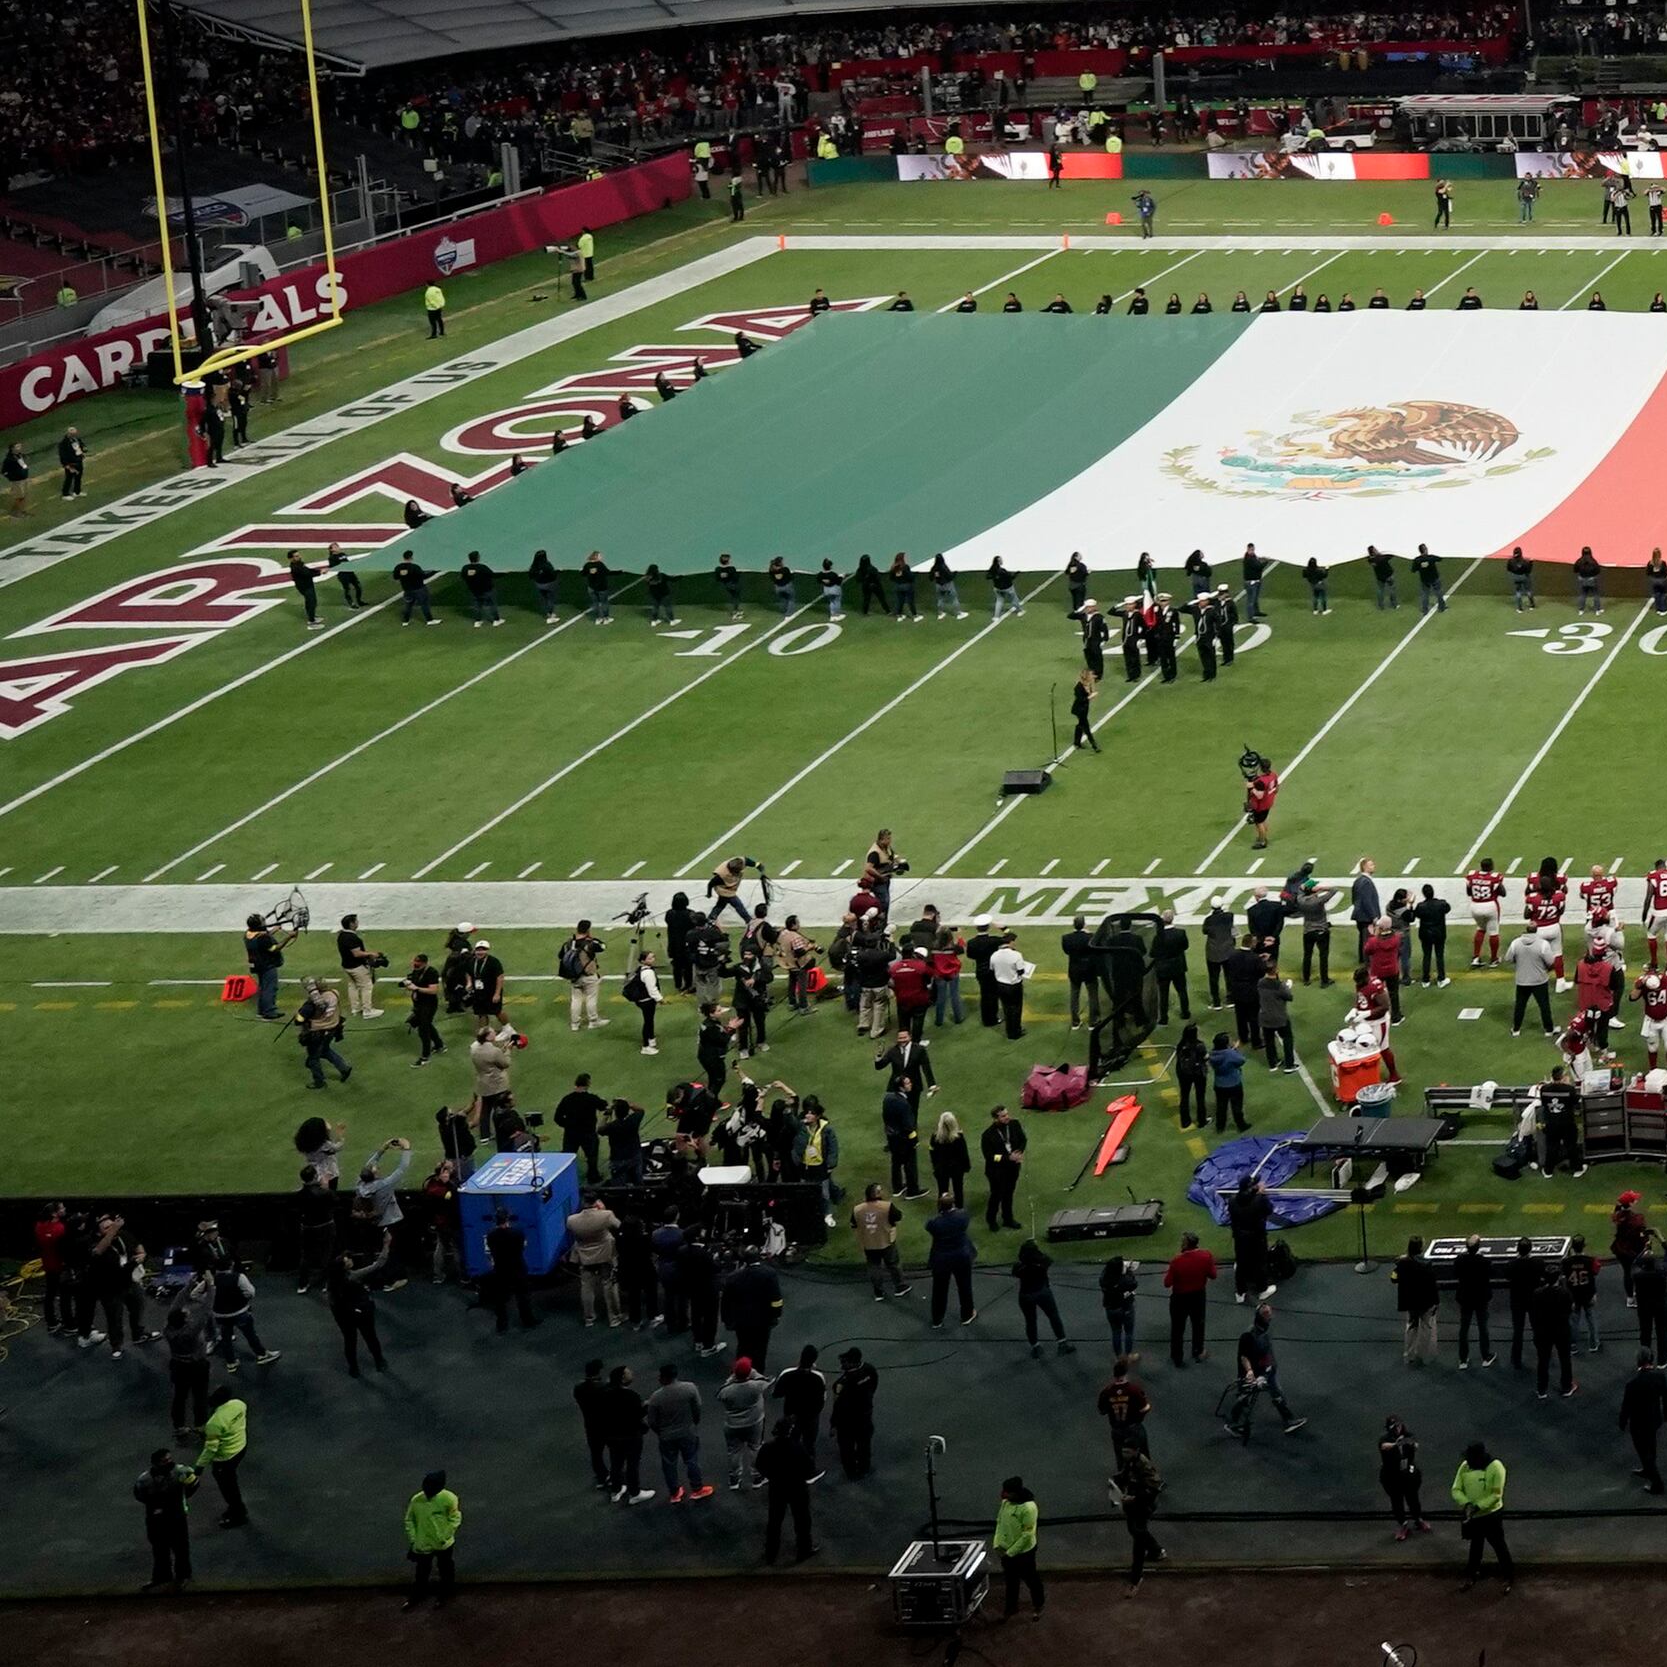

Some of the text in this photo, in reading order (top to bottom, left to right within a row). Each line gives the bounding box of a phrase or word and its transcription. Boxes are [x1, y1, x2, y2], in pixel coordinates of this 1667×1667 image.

[337, 394, 416, 418] OF
[414, 359, 499, 386] US
[675, 622, 844, 657] 10
[1539, 905, 1559, 921] 72
[227, 979, 245, 998] 10
[1647, 991, 1667, 1006] 64
